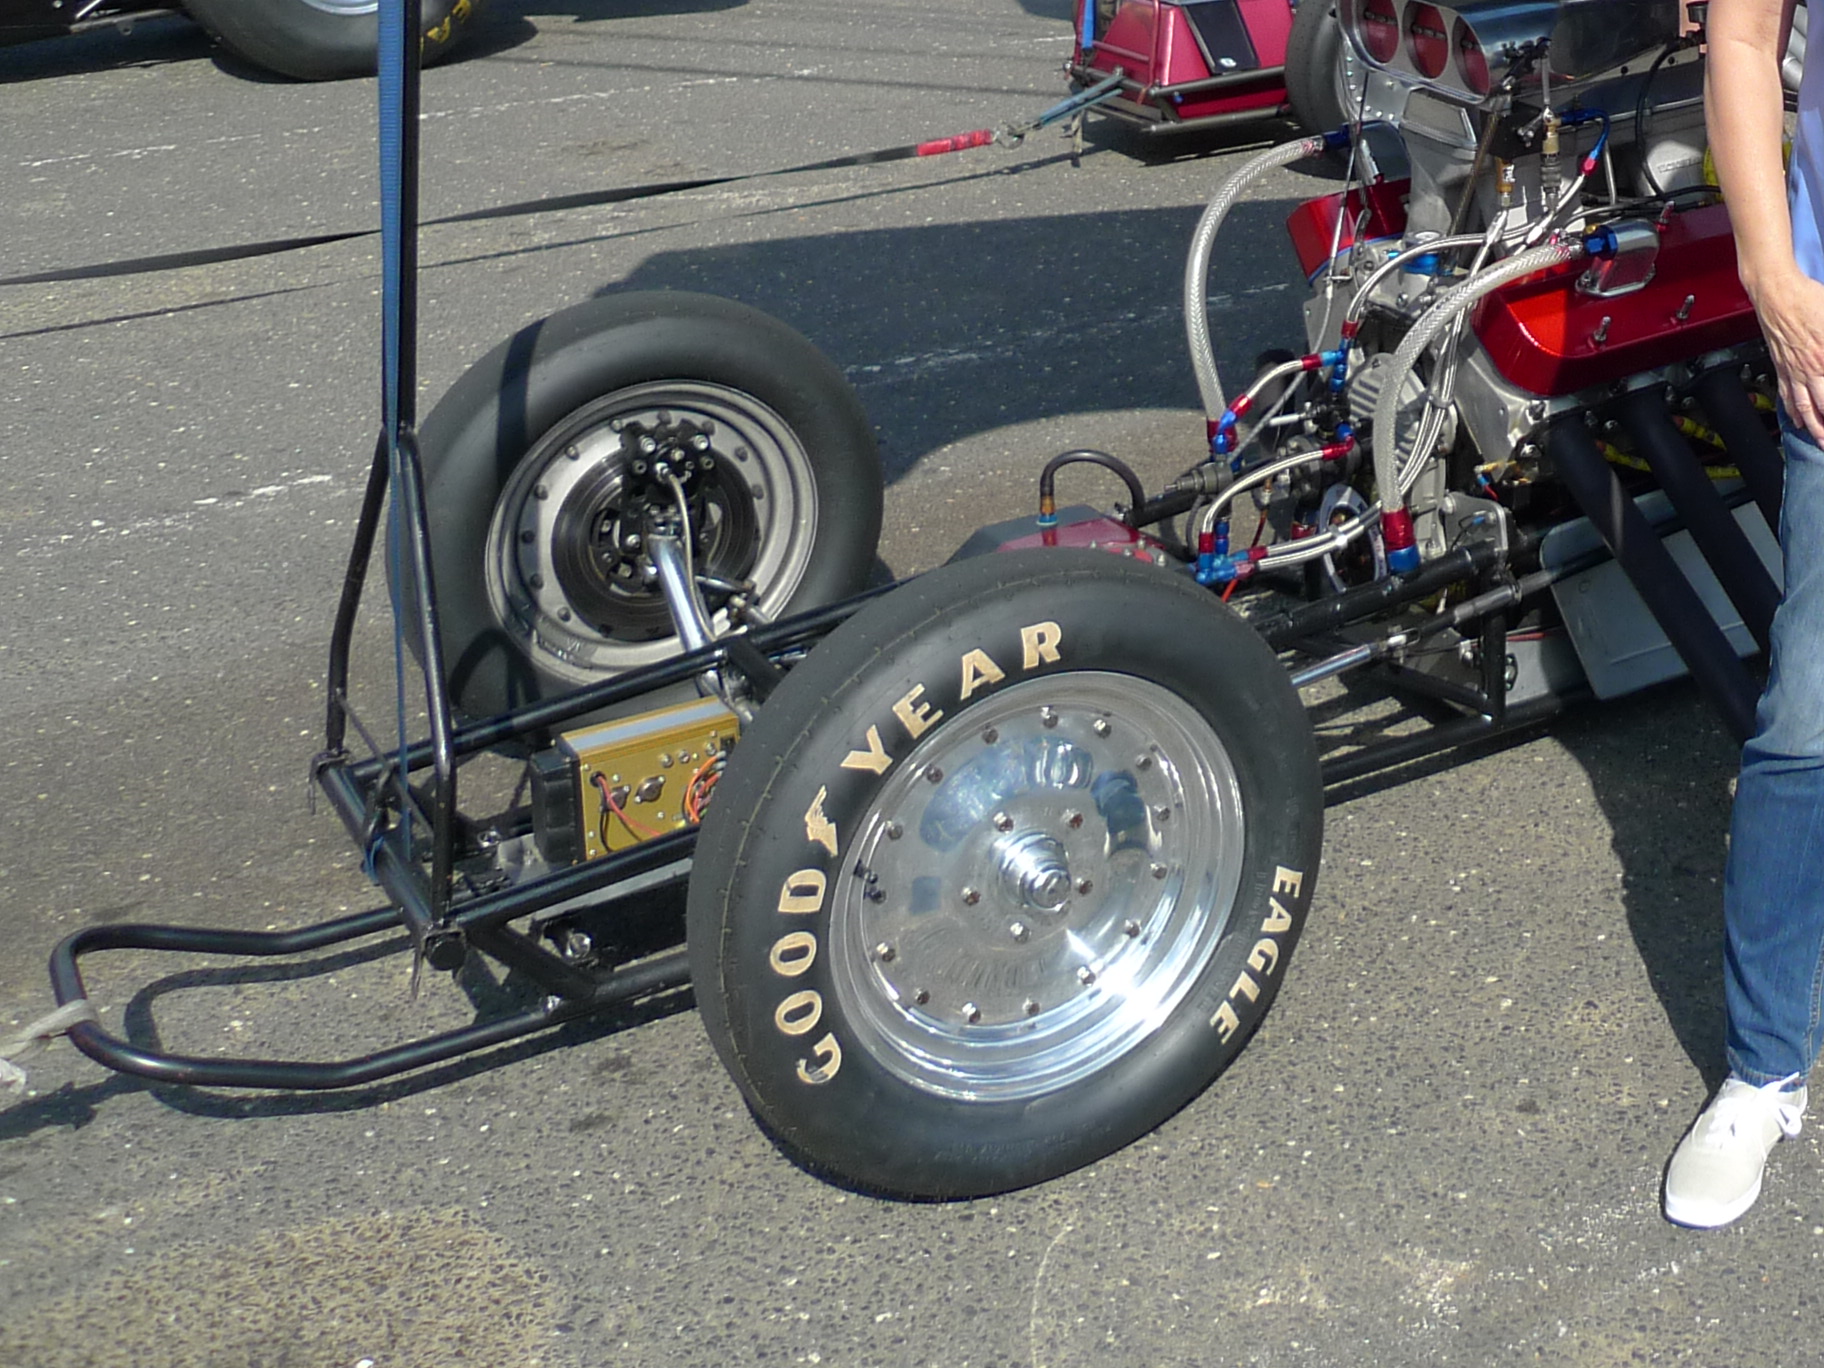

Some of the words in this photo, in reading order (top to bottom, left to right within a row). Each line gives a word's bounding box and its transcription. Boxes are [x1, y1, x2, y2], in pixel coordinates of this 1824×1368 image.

[770, 868, 842, 1084] GOOD
[840, 621, 1062, 775] YEAR
[1209, 865, 1304, 1045] EAGLE
